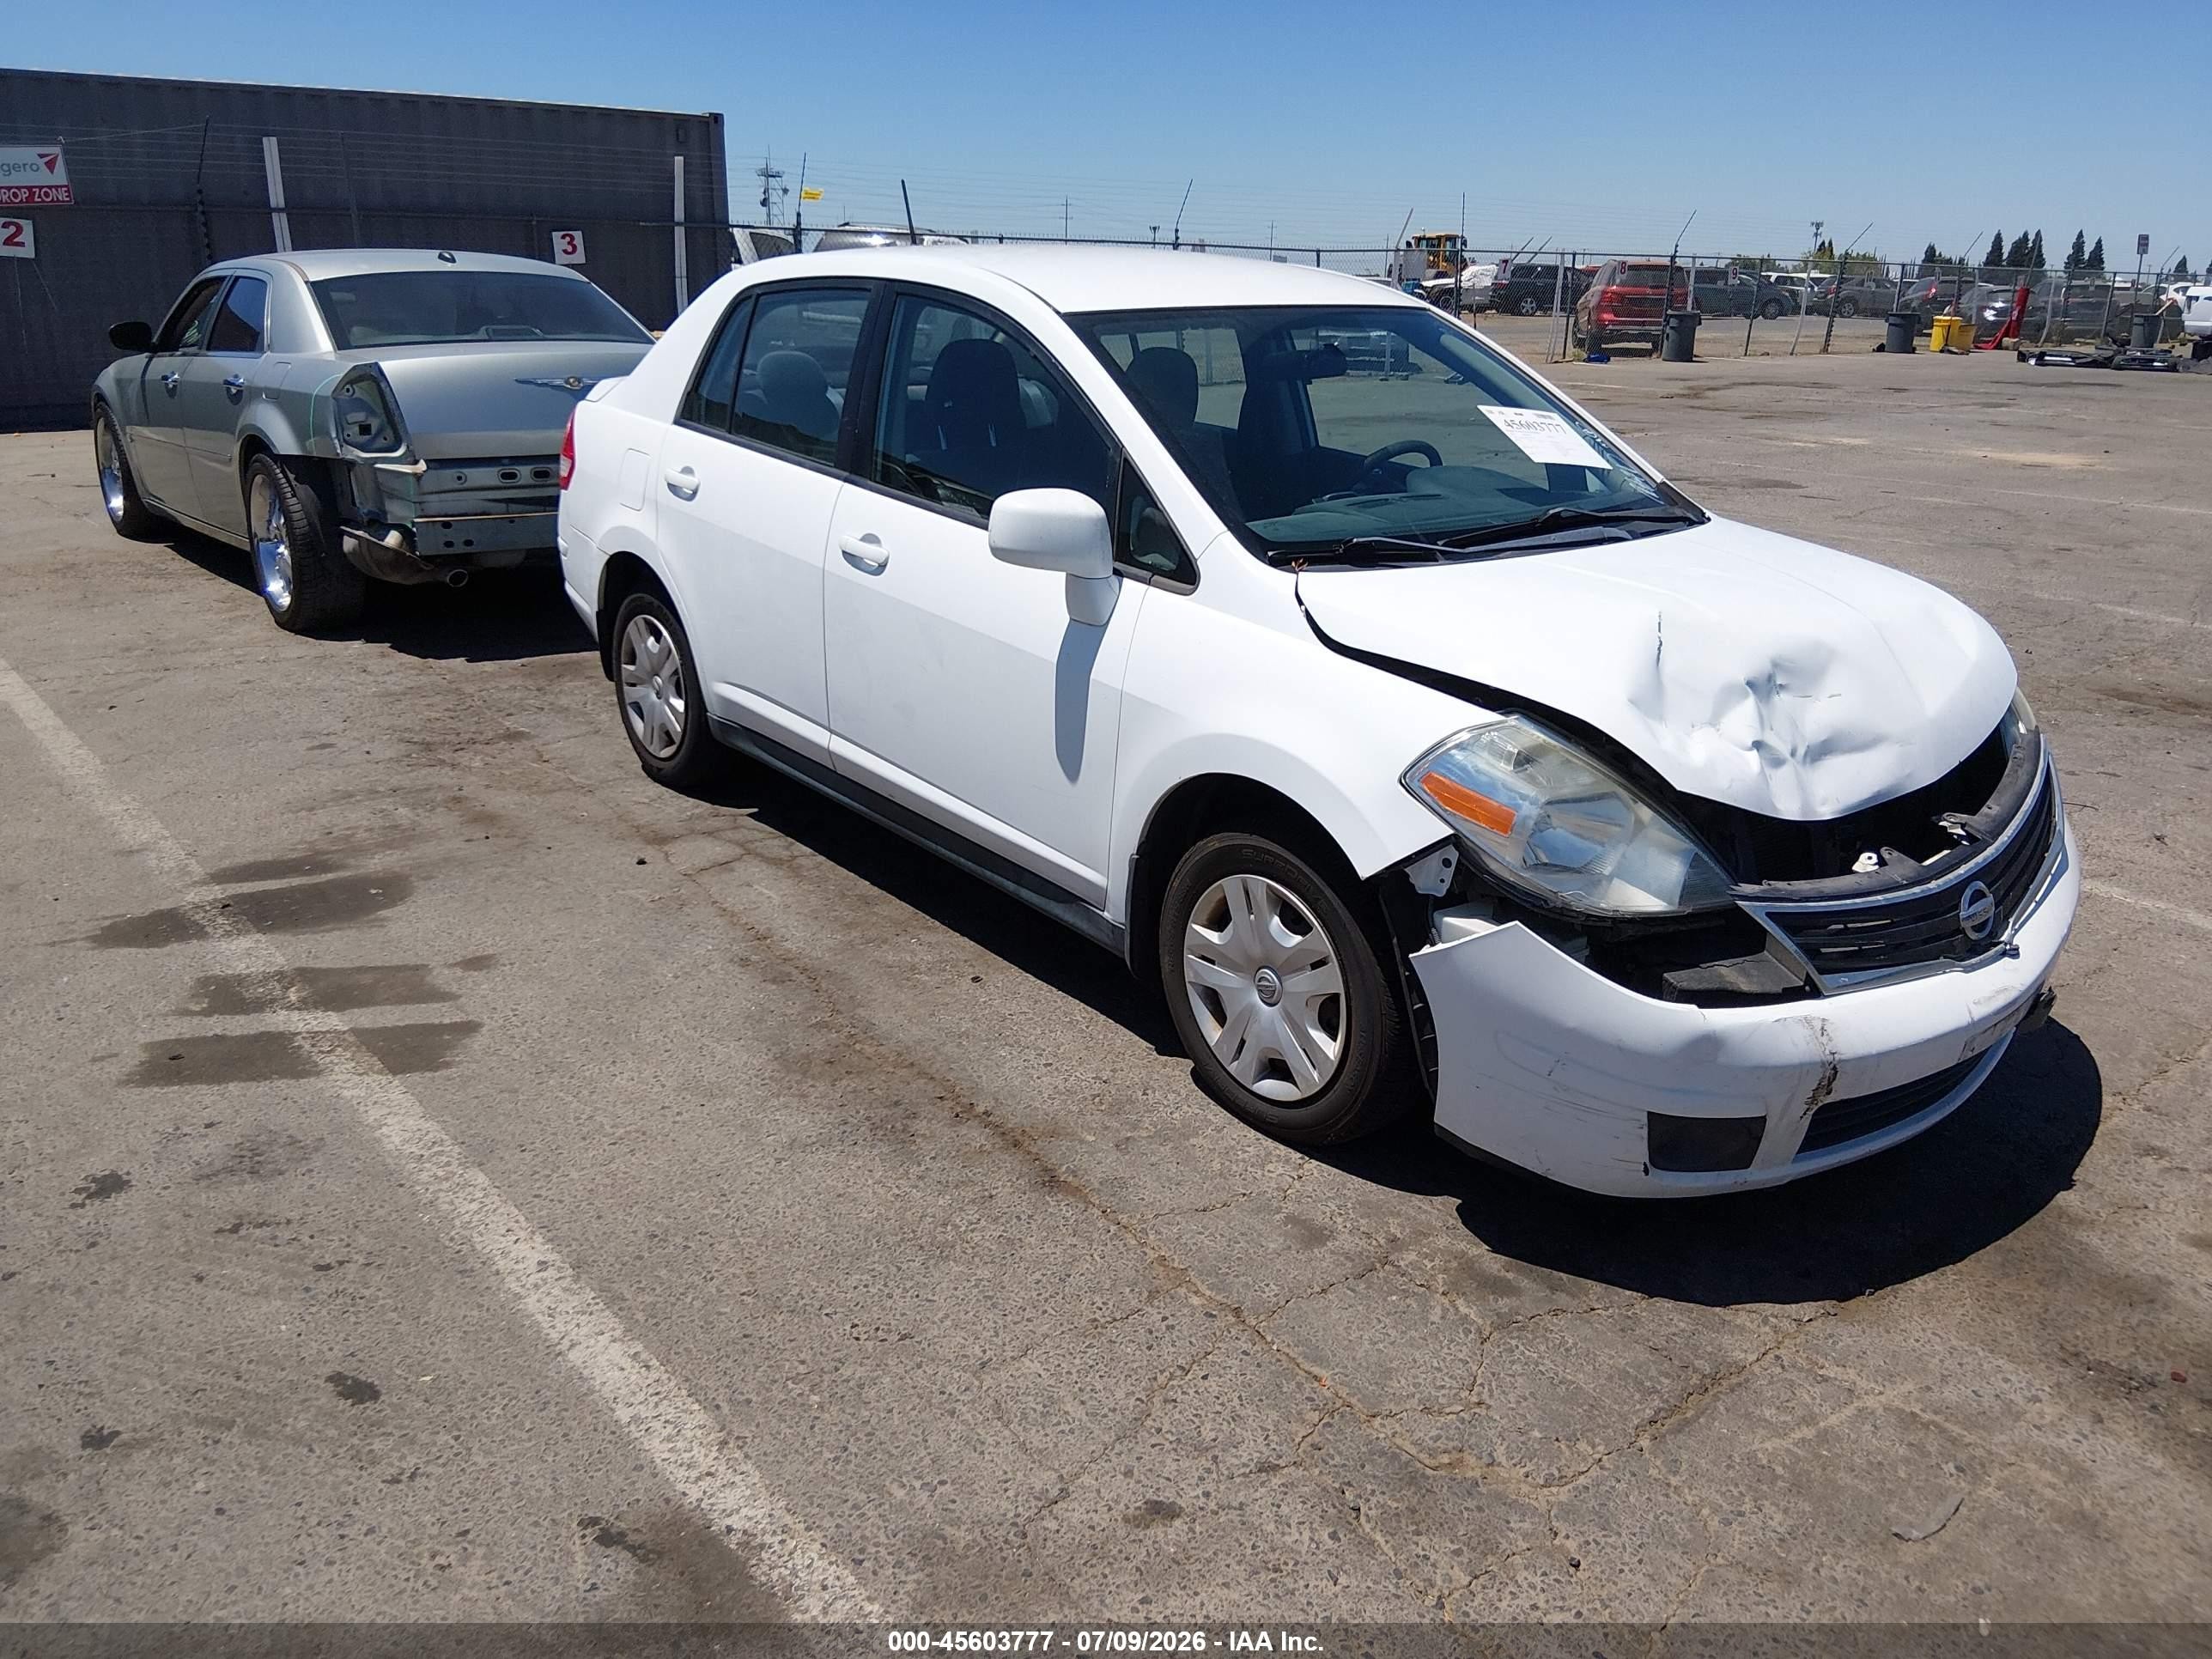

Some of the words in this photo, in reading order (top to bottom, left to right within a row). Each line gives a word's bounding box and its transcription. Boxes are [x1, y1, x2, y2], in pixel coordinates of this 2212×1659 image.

[0, 162, 40, 177] gero
[0, 188, 29, 203] ROP
[33, 187, 70, 202] ZONE
[1, 221, 26, 247] 2
[560, 233, 578, 256] 3
[1501, 259, 1509, 274] 7
[1620, 261, 1626, 275] 8
[1732, 267, 1738, 280] 9
[1504, 418, 1567, 434] 45603777
